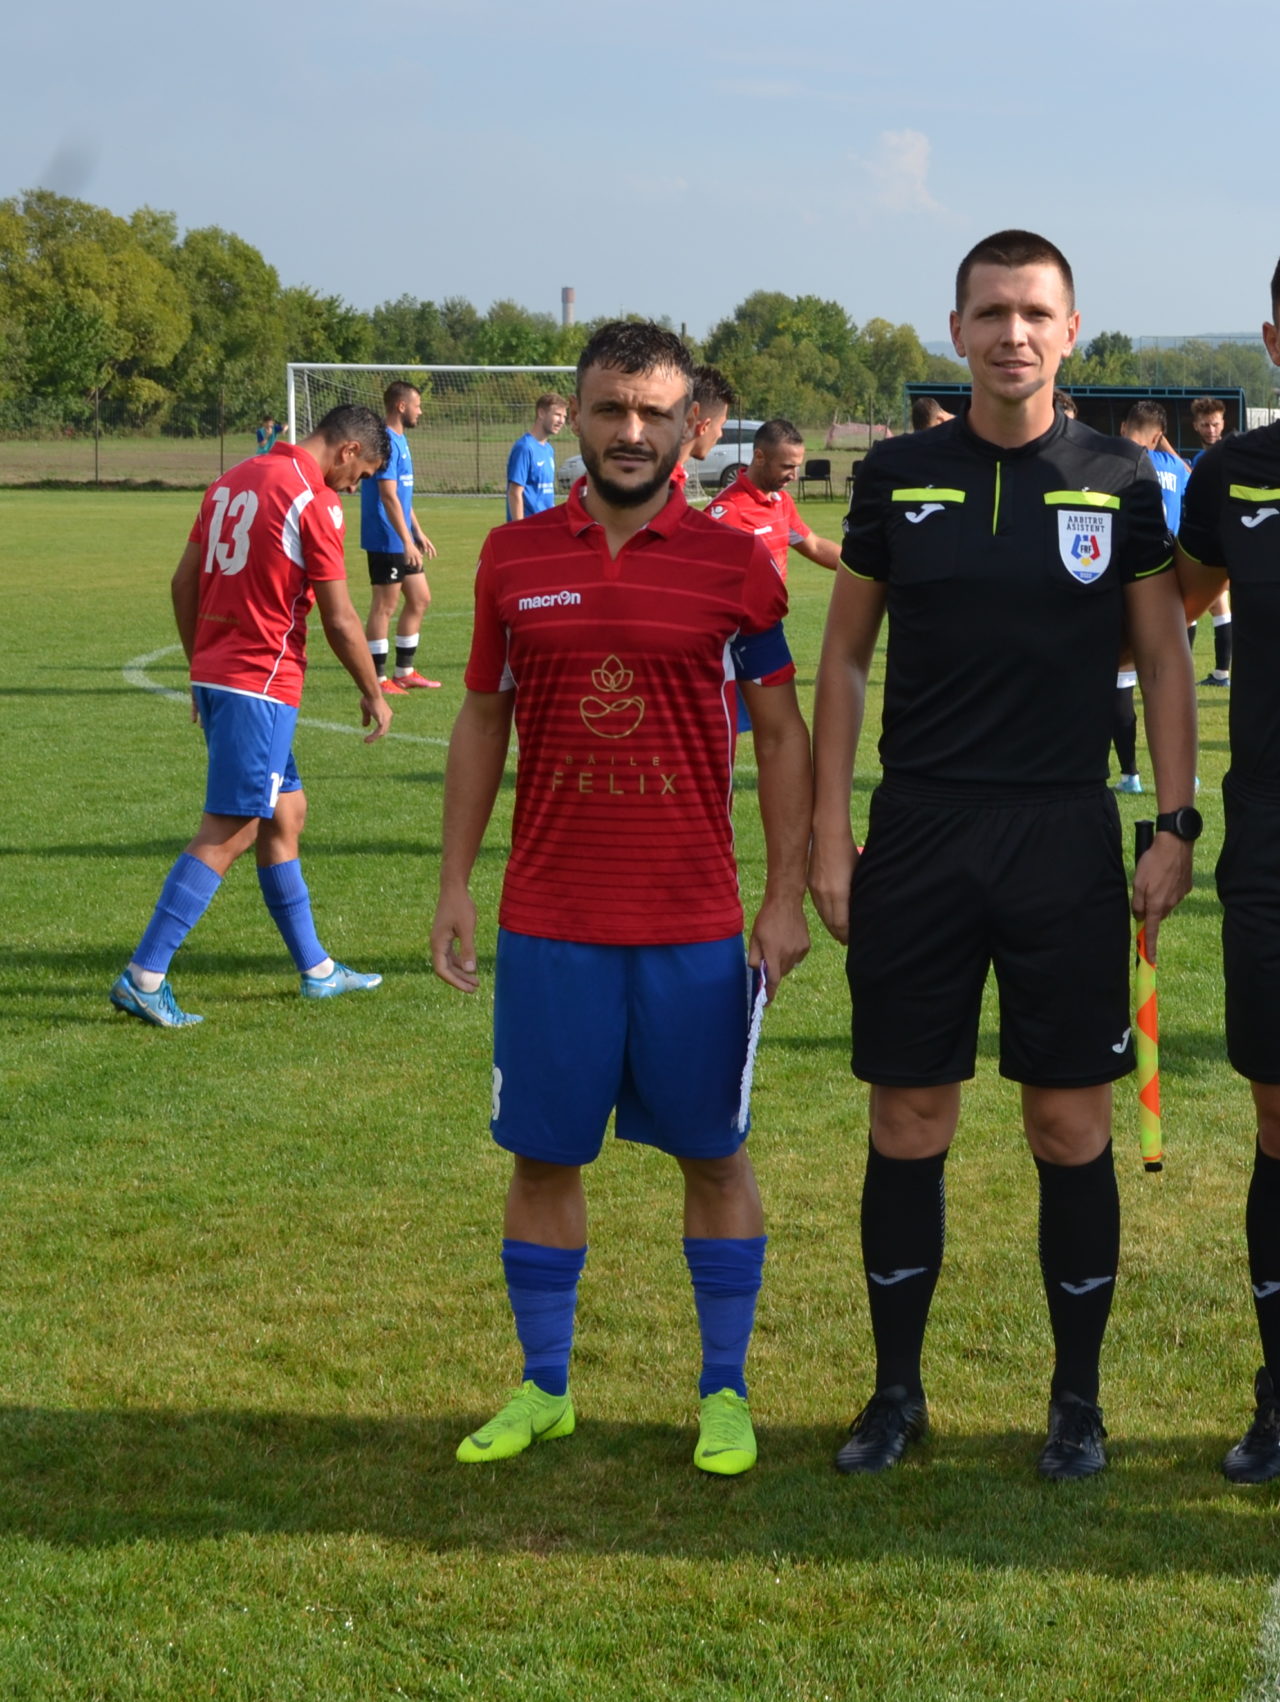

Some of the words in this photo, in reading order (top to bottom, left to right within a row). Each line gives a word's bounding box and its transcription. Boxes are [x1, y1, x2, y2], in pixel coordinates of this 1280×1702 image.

[1066, 523, 1106, 533] ASISTENT
[1068, 515, 1104, 525] ARBITRU
[204, 487, 259, 576] 13
[390, 567, 399, 580] 2
[518, 590, 582, 611] macron
[552, 771, 677, 795] FELIX
